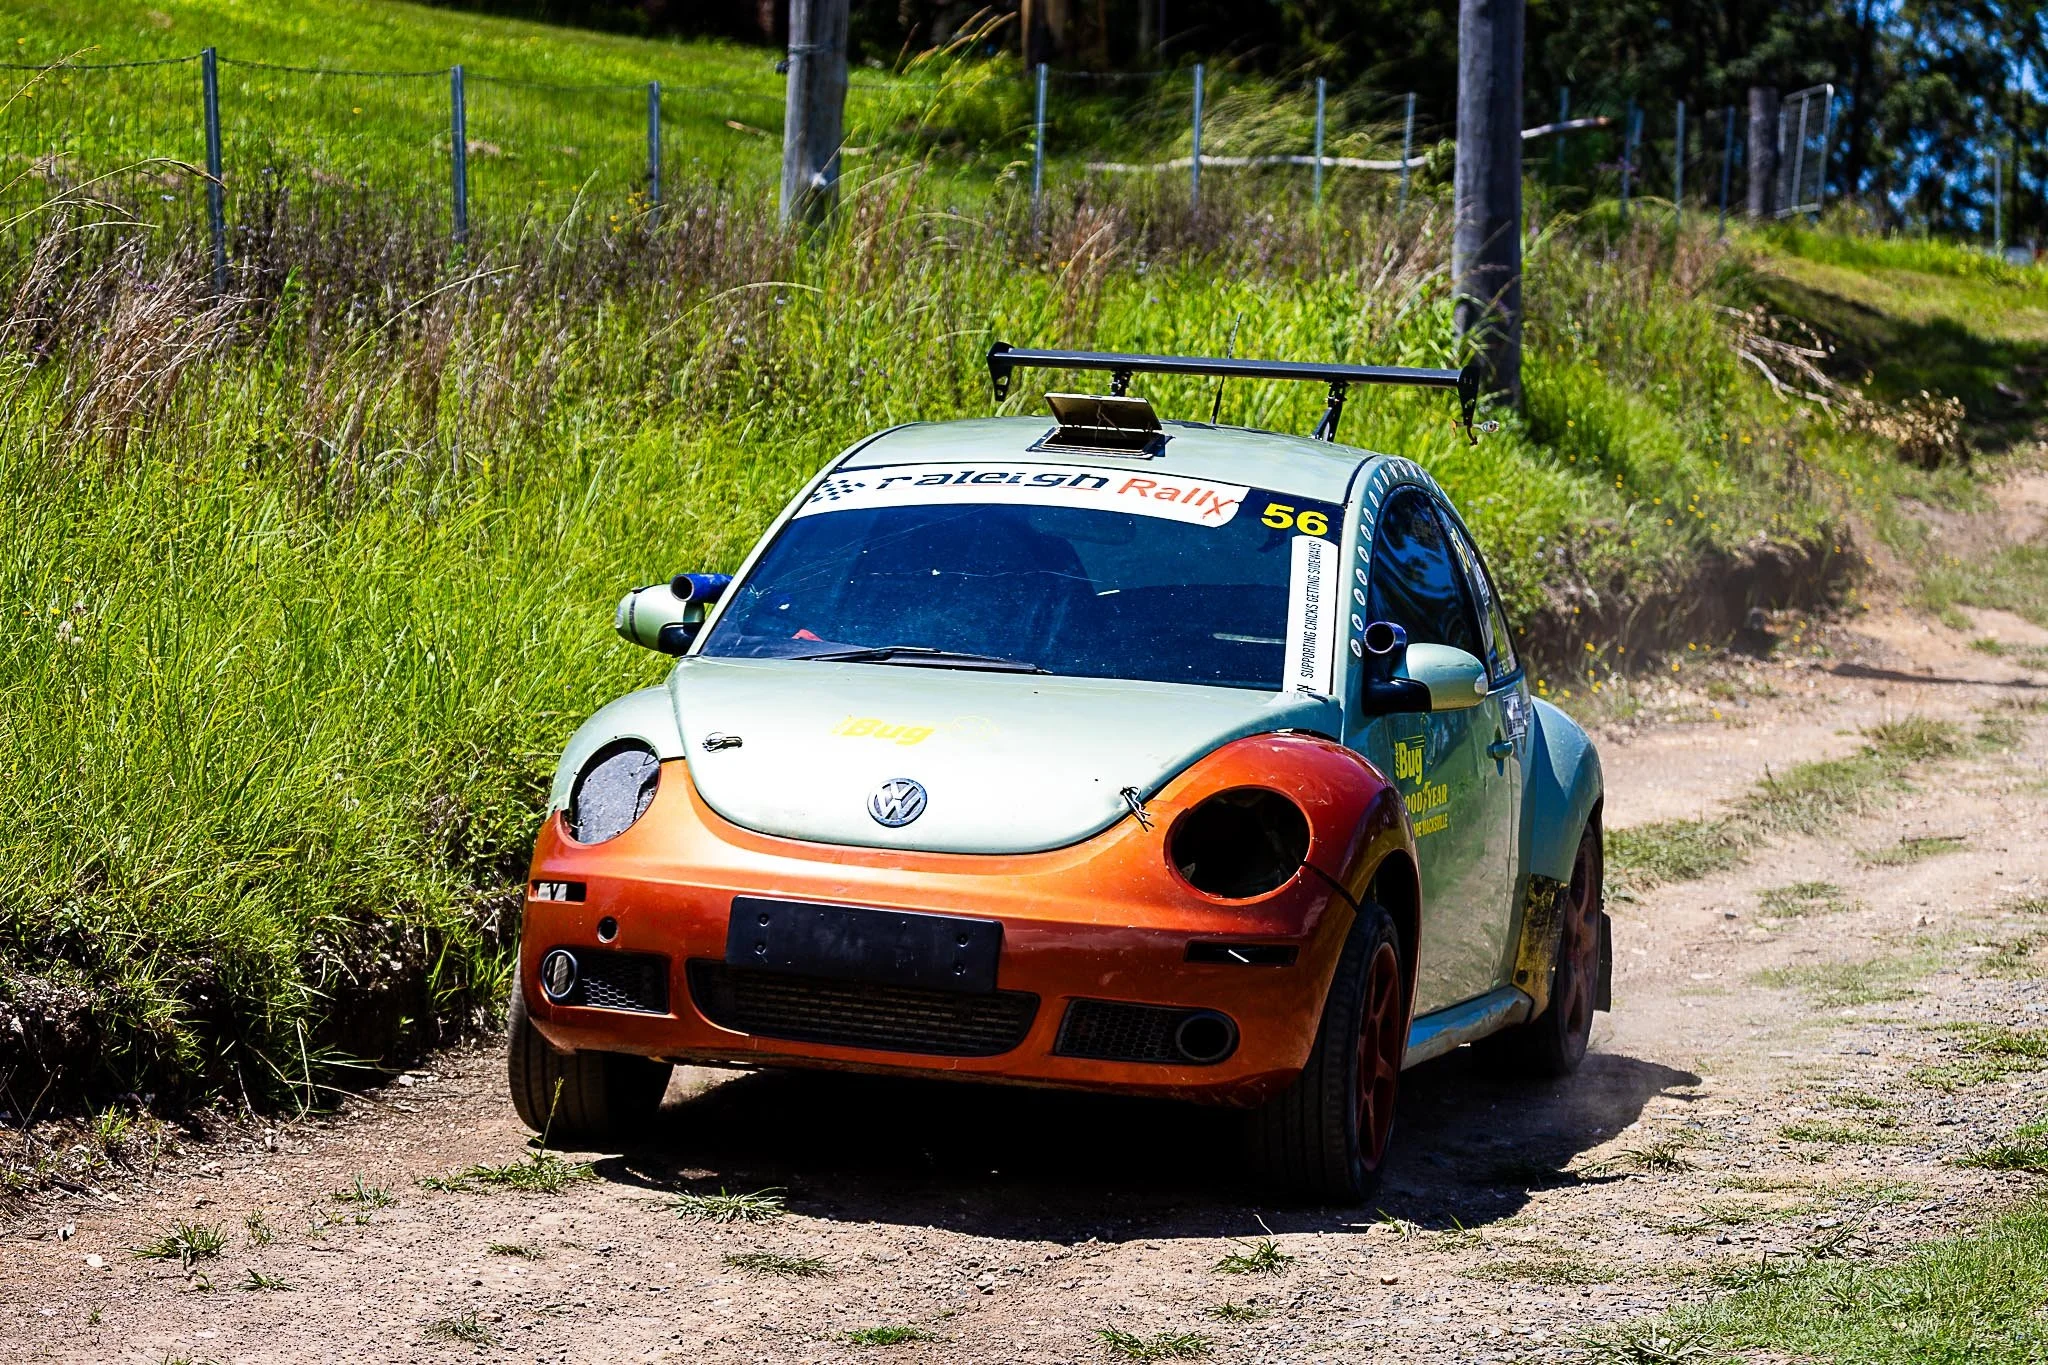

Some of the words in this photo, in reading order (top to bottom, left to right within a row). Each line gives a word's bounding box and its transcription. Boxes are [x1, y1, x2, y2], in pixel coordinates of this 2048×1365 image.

[876, 470, 1107, 491] raleigh
[1117, 478, 1235, 520] Rally
[1261, 503, 1328, 535] 56
[1306, 574, 1321, 603] GETTING
[1305, 603, 1319, 631] CHICKS
[1301, 632, 1317, 679] SUPPORTING
[1399, 742, 1422, 785] Bug
[1404, 780, 1448, 816] OODYEAR
